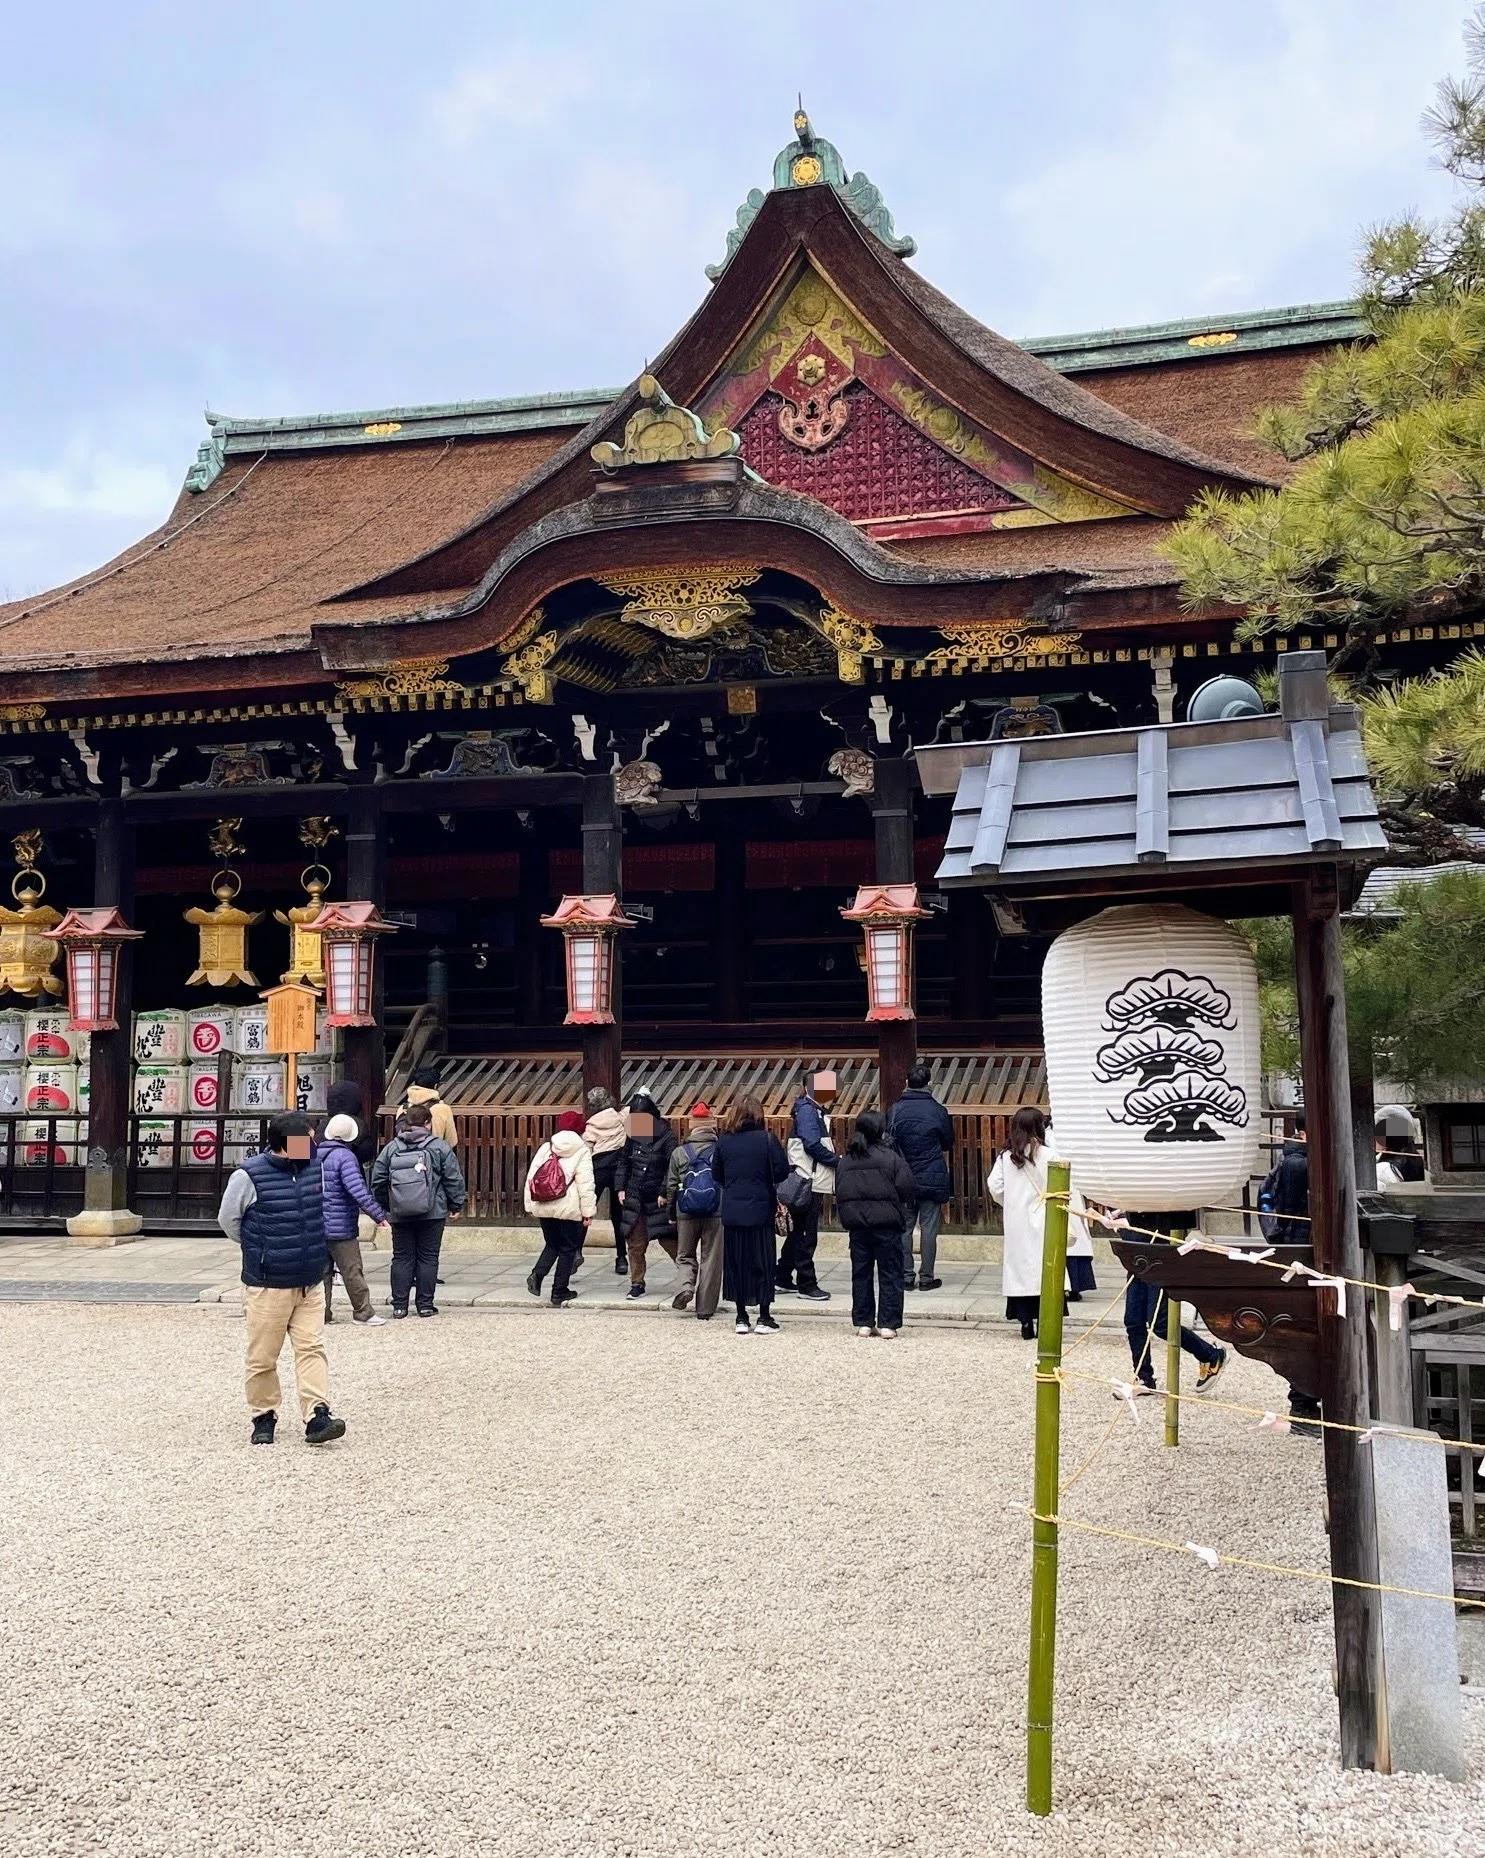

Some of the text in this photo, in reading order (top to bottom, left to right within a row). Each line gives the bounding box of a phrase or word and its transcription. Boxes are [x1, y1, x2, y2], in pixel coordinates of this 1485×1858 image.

[37, 1019, 50, 1057] 櫻正宗
[36, 1072, 50, 1110] 櫻正宗
